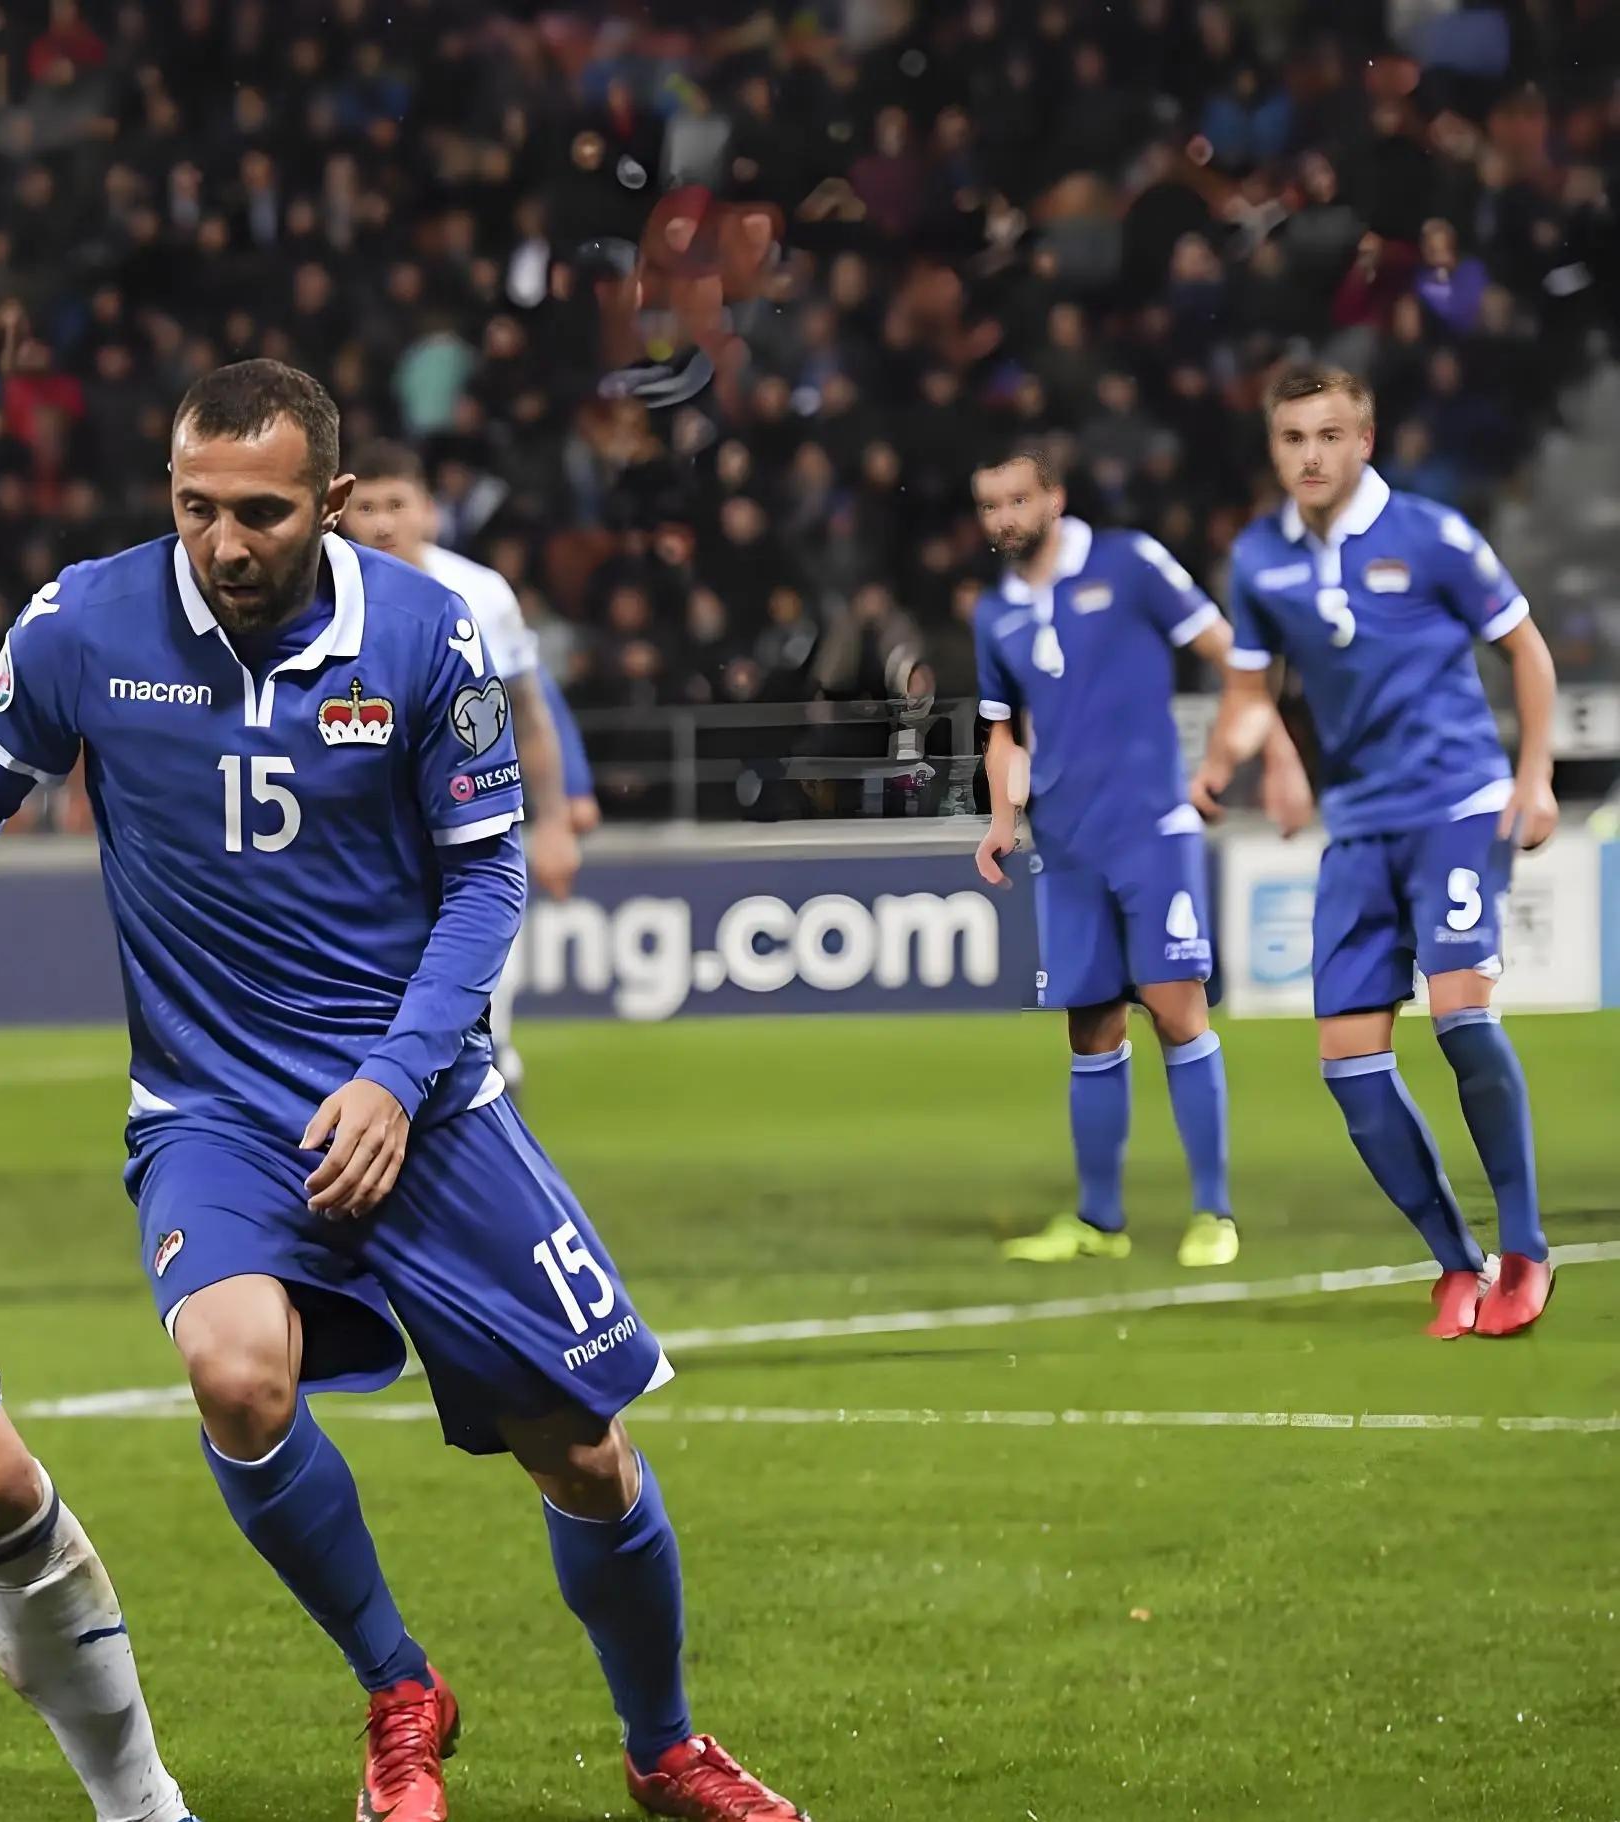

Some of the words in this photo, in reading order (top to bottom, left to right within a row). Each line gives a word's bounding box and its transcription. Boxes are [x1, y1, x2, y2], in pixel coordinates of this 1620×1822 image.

[109, 678, 212, 706] macron
[217, 755, 302, 853] 15
[533, 1220, 615, 1335] 15
[563, 1314, 638, 1371] macron
